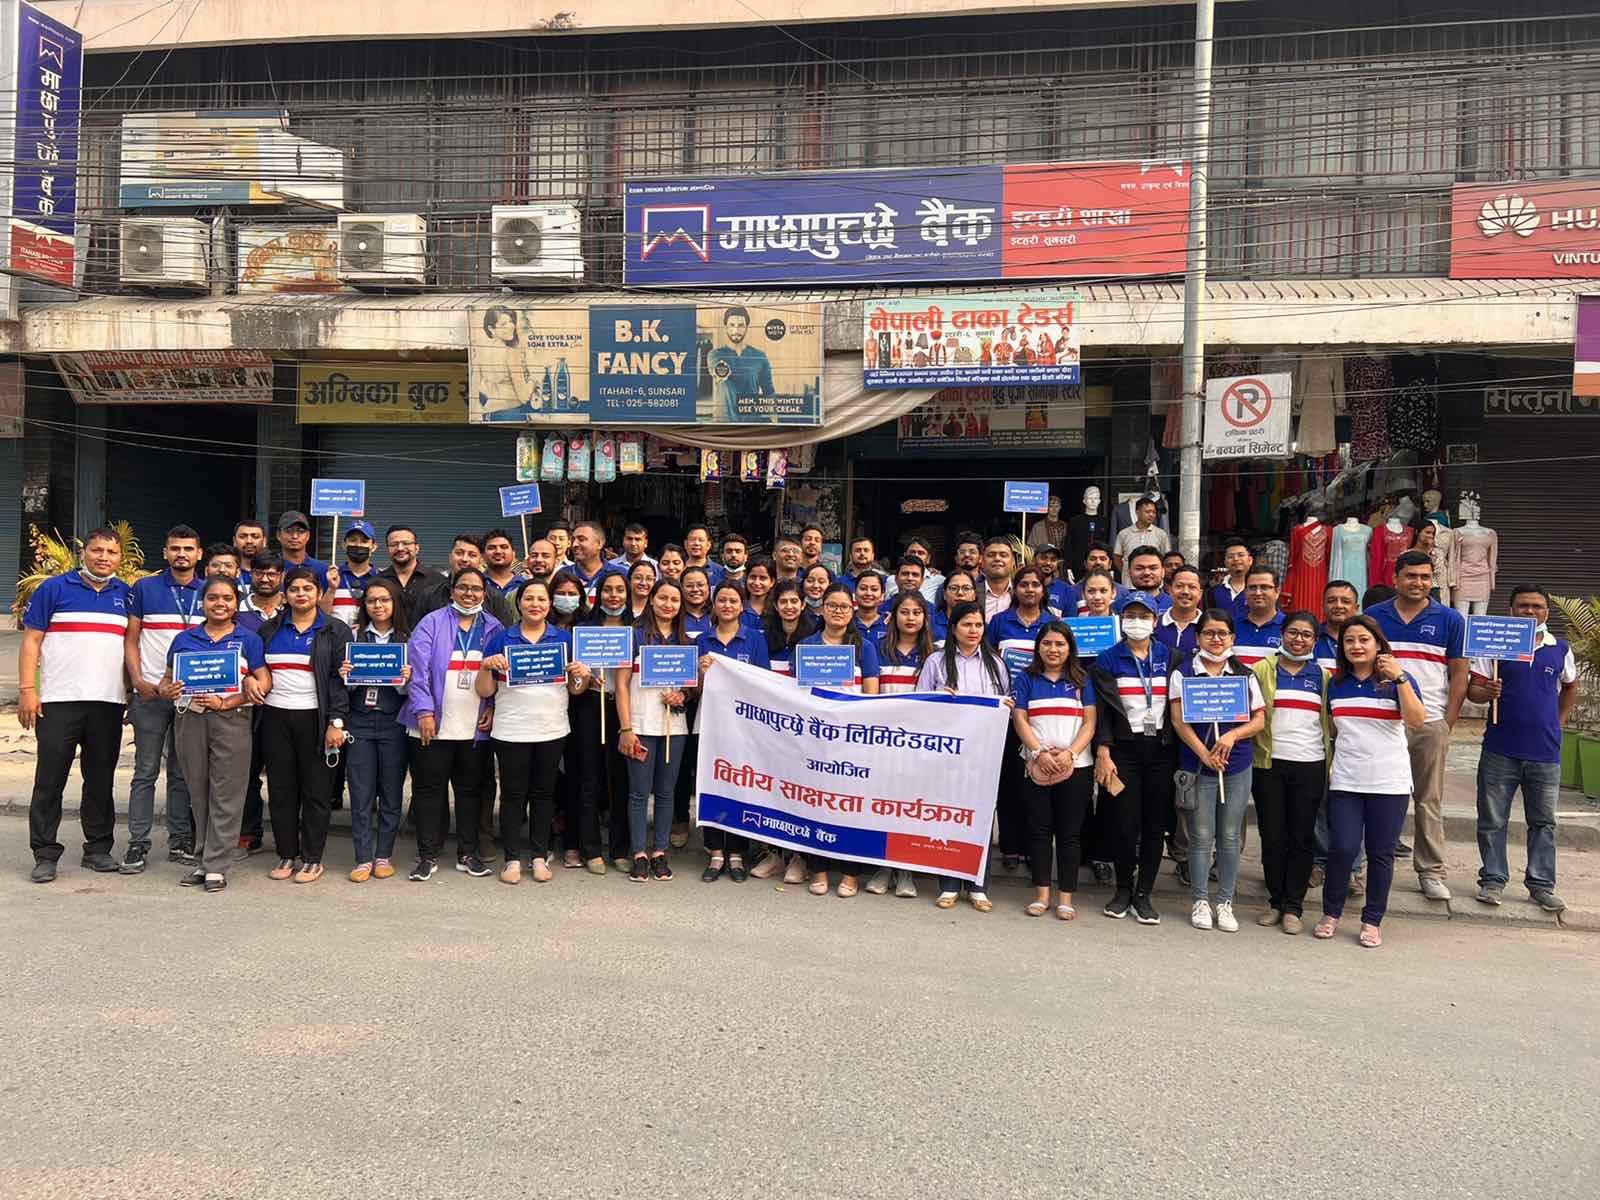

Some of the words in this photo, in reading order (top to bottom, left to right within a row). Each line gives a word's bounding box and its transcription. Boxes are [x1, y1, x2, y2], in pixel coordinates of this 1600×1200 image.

[1552, 208, 1600, 230] HU
[870, 306, 944, 331] नेपाली
[951, 310, 1009, 329] ढाका
[614, 319, 670, 343] B.K.
[598, 352, 687, 376] FANCY
[407, 382, 450, 410] बुक
[648, 386, 686, 396] SUNSARI
[735, 699, 805, 736] माछापुच्छ्रे
[808, 715, 840, 741] बैंक
[845, 723, 964, 755] लिमिटेडद्वारा
[806, 758, 871, 779] आयोजित
[713, 758, 773, 792] वित्तीय
[779, 778, 865, 814] साक्षरता
[871, 798, 976, 828] कार्यक्रम
